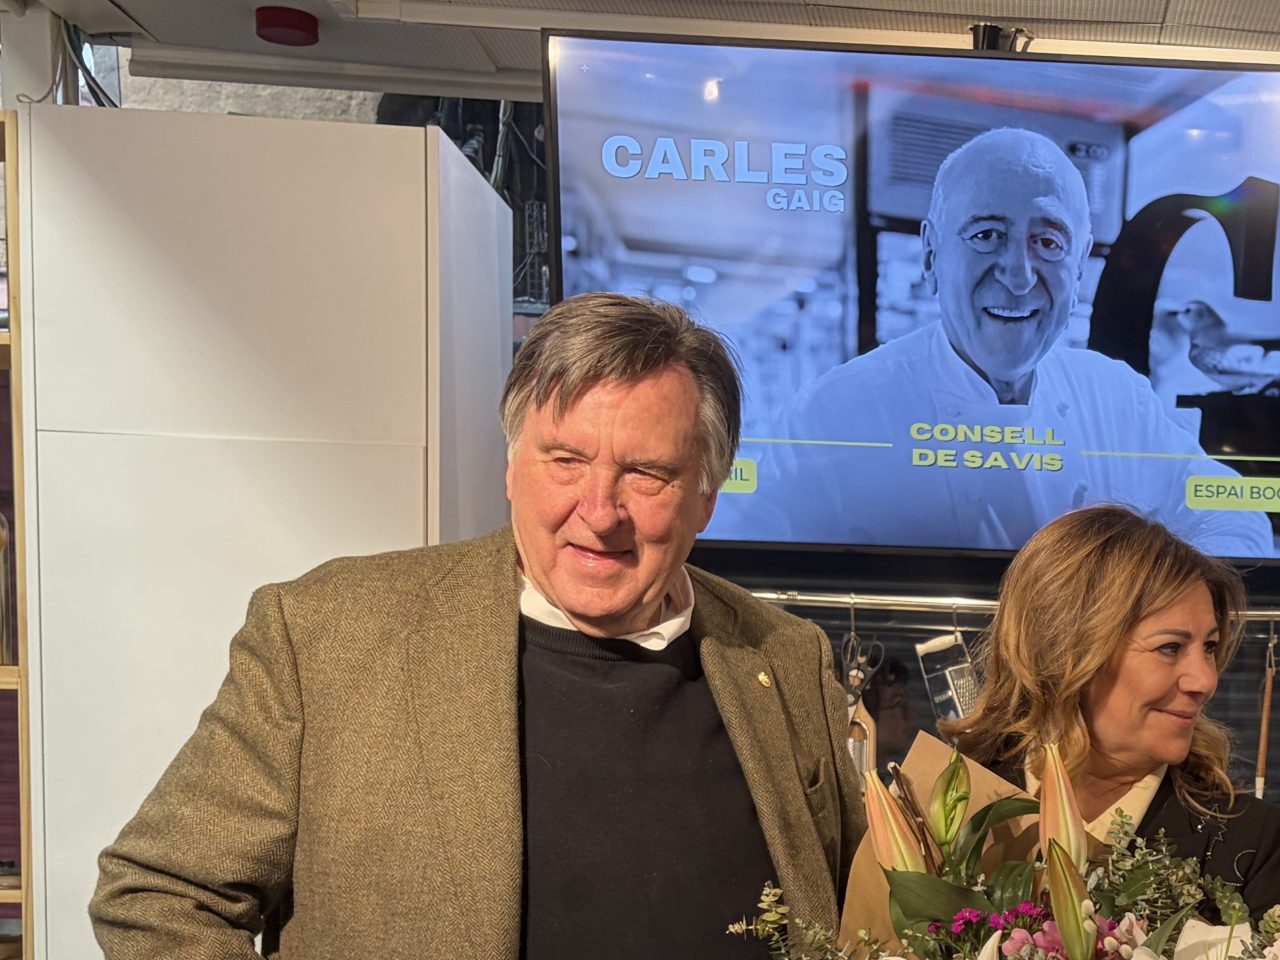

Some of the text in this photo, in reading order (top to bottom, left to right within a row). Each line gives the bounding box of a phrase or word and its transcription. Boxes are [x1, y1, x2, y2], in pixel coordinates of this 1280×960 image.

[601, 135, 848, 187] CARLES
[766, 188, 845, 213] GAIG
[910, 422, 1065, 445] CONSELL
[912, 448, 1064, 471] DE SAVIS
[1193, 484, 1244, 499] ESPAI
